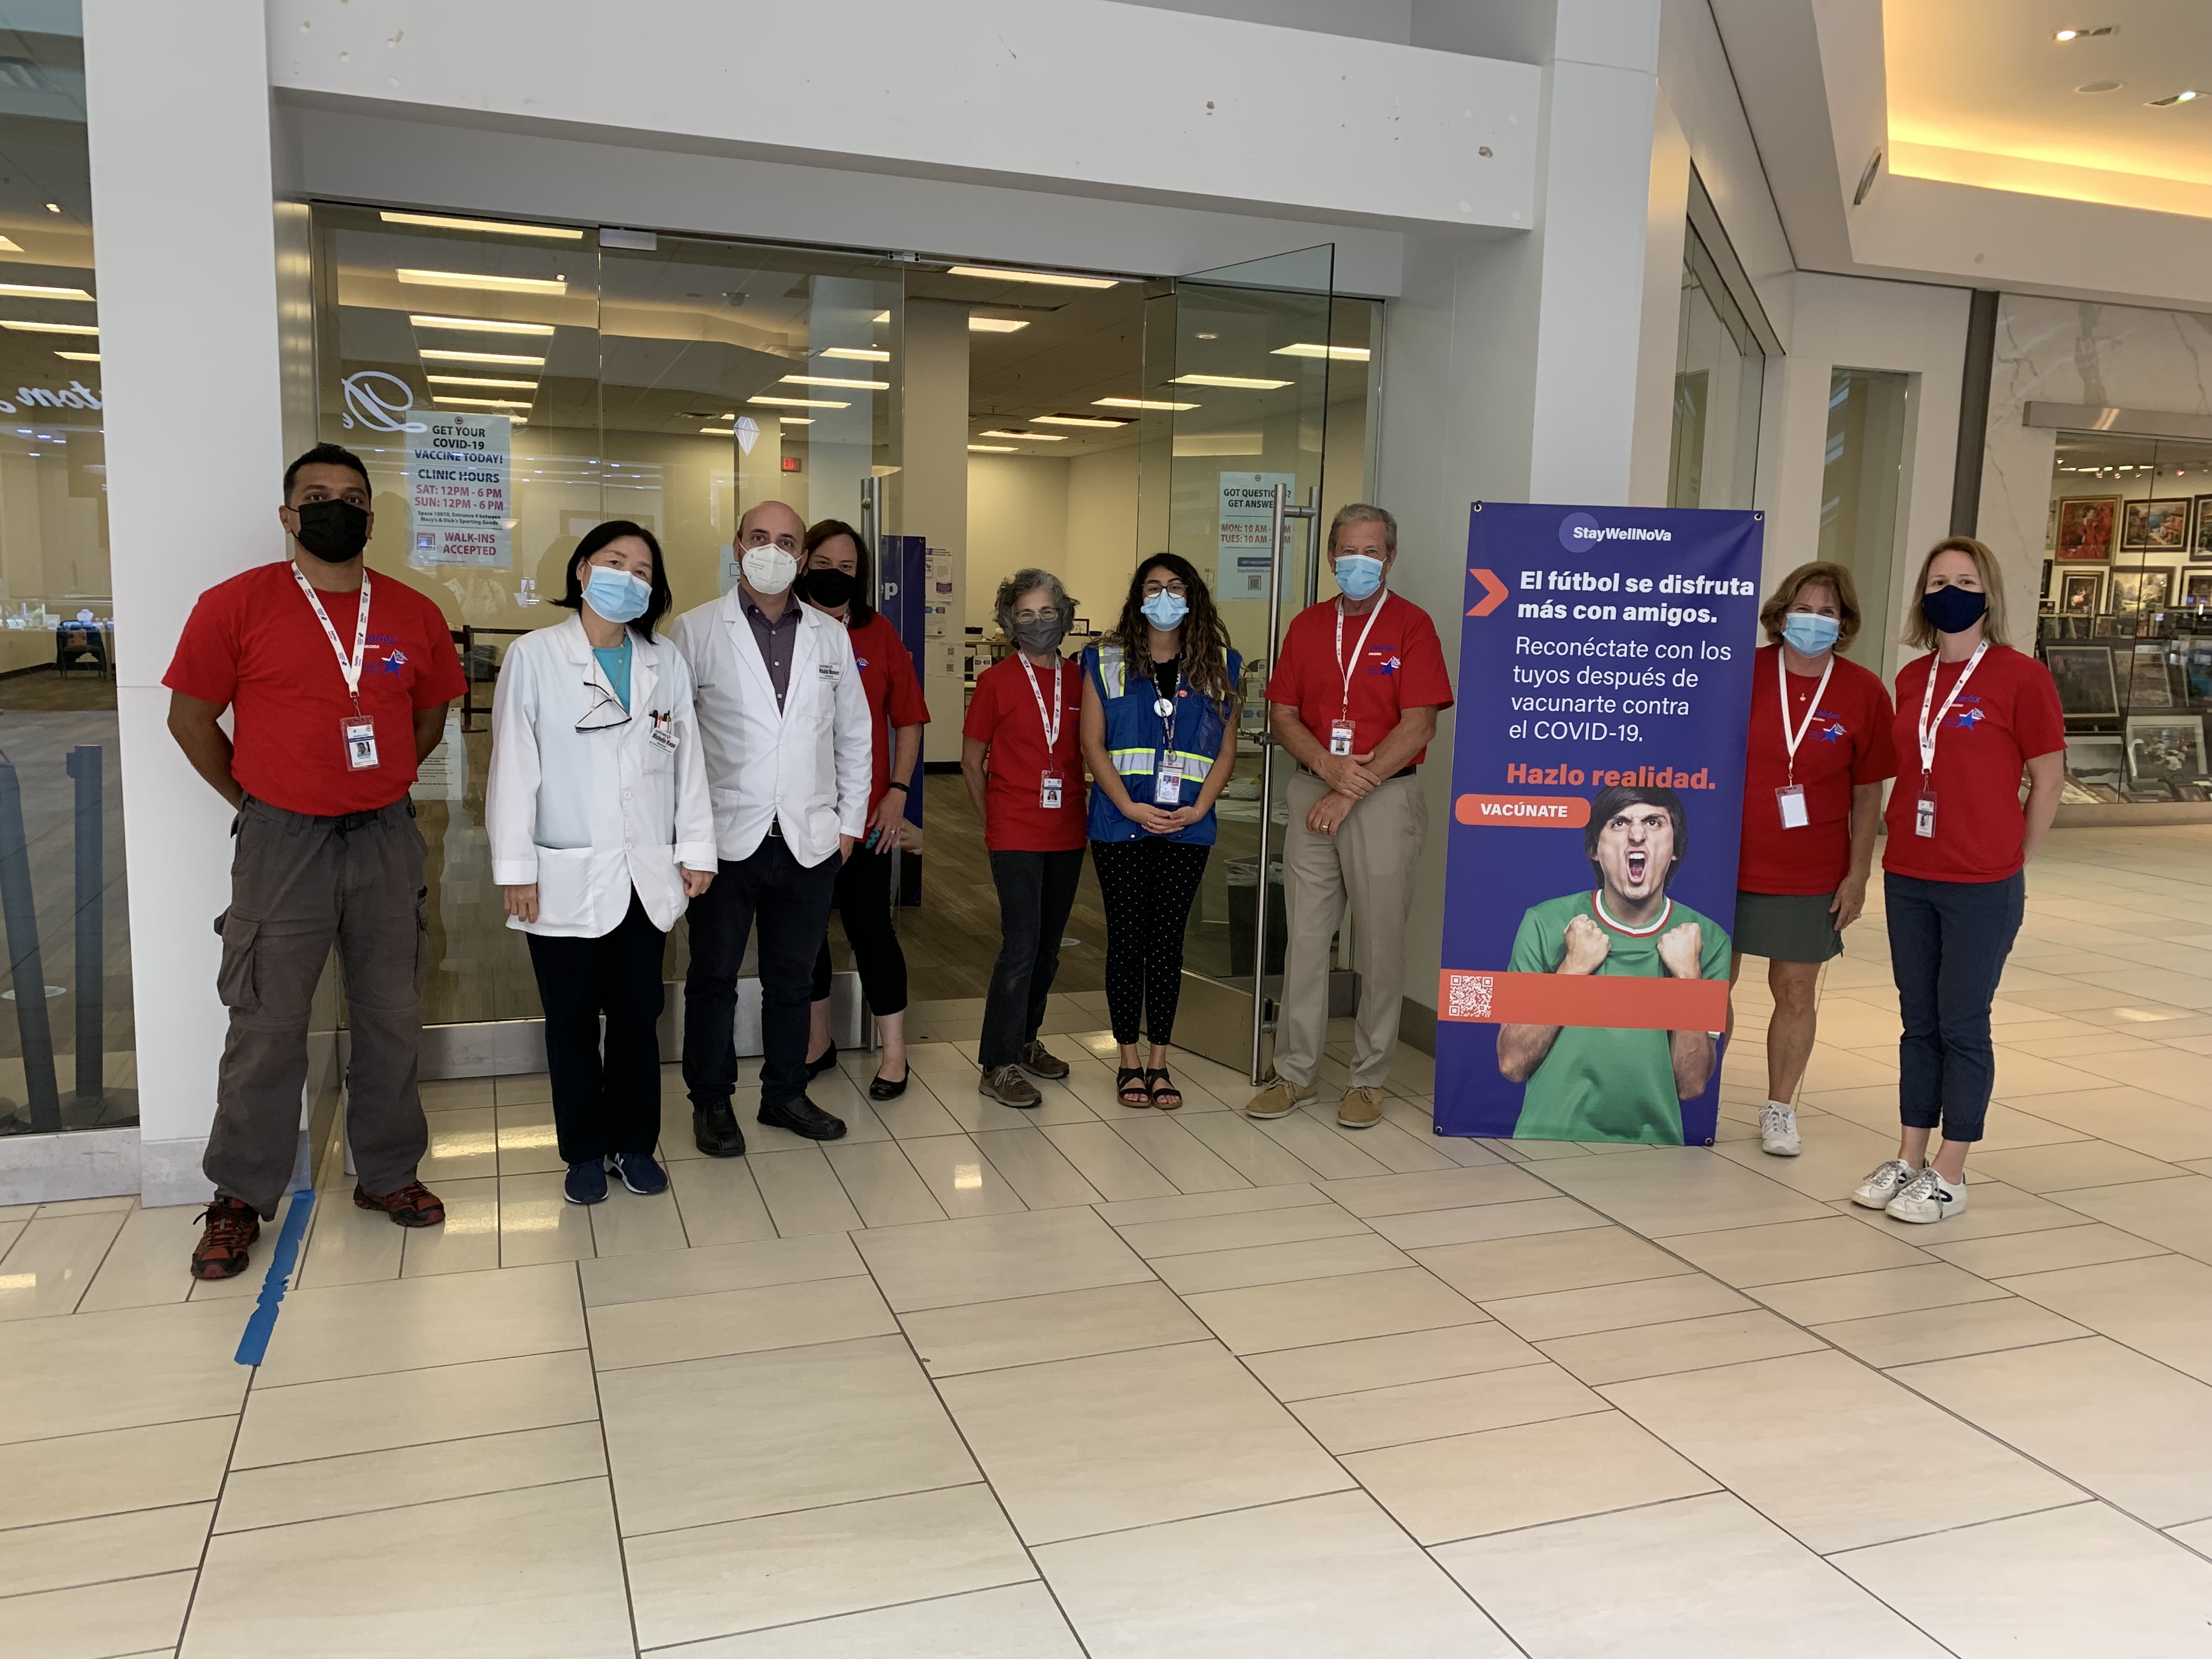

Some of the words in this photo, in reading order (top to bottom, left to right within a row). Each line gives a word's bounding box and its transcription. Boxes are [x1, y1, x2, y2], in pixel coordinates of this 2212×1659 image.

[432, 426, 453, 435] GET
[455, 427, 486, 437] YOUR
[433, 438, 484, 450] COVID-19
[415, 449, 461, 461] VACCINE
[464, 453, 503, 464] TODAY!
[418, 469, 456, 481] CLINIC
[459, 471, 500, 483] HOURS
[416, 484, 438, 494] SAT:
[441, 486, 469, 496] 12PM
[477, 488, 484, 497] 6
[486, 488, 502, 498] PM
[415, 496, 440, 507] SUN:
[442, 498, 471, 509] 12PM
[479, 500, 486, 509] 6
[488, 501, 504, 511] PM
[1221, 524, 1243, 532] MON:
[1255, 524, 1267, 533] AM
[1573, 526, 1672, 542] StayWellNoVa
[444, 532, 495, 544] WALK-INS
[1221, 534, 1243, 543] TUES:
[443, 544, 496, 556] ACCEPTED
[1520, 571, 1543, 590] El
[1549, 571, 1620, 593] fútbol
[1625, 577, 1654, 594] se
[1659, 574, 1754, 596] disfruta
[1518, 599, 1567, 619] más
[1573, 605, 1617, 621] con
[1623, 602, 1718, 626] amigos.
[366, 634, 397, 644] airfax
[1516, 636, 1649, 658] Reconéctate
[1655, 642, 1694, 659] con
[1701, 641, 1731, 661] los
[1513, 667, 1571, 688] tuyos
[1576, 667, 1666, 691] después
[1672, 668, 1699, 688] de
[1511, 695, 1616, 714] vacunarte
[1623, 698, 1689, 716] contra
[1509, 720, 1527, 740] el
[1534, 721, 1643, 743] COVID-19.
[1506, 763, 1585, 786] Hazlo
[1592, 766, 1716, 790] realidad.
[1480, 802, 1568, 818] VACÚNATE
